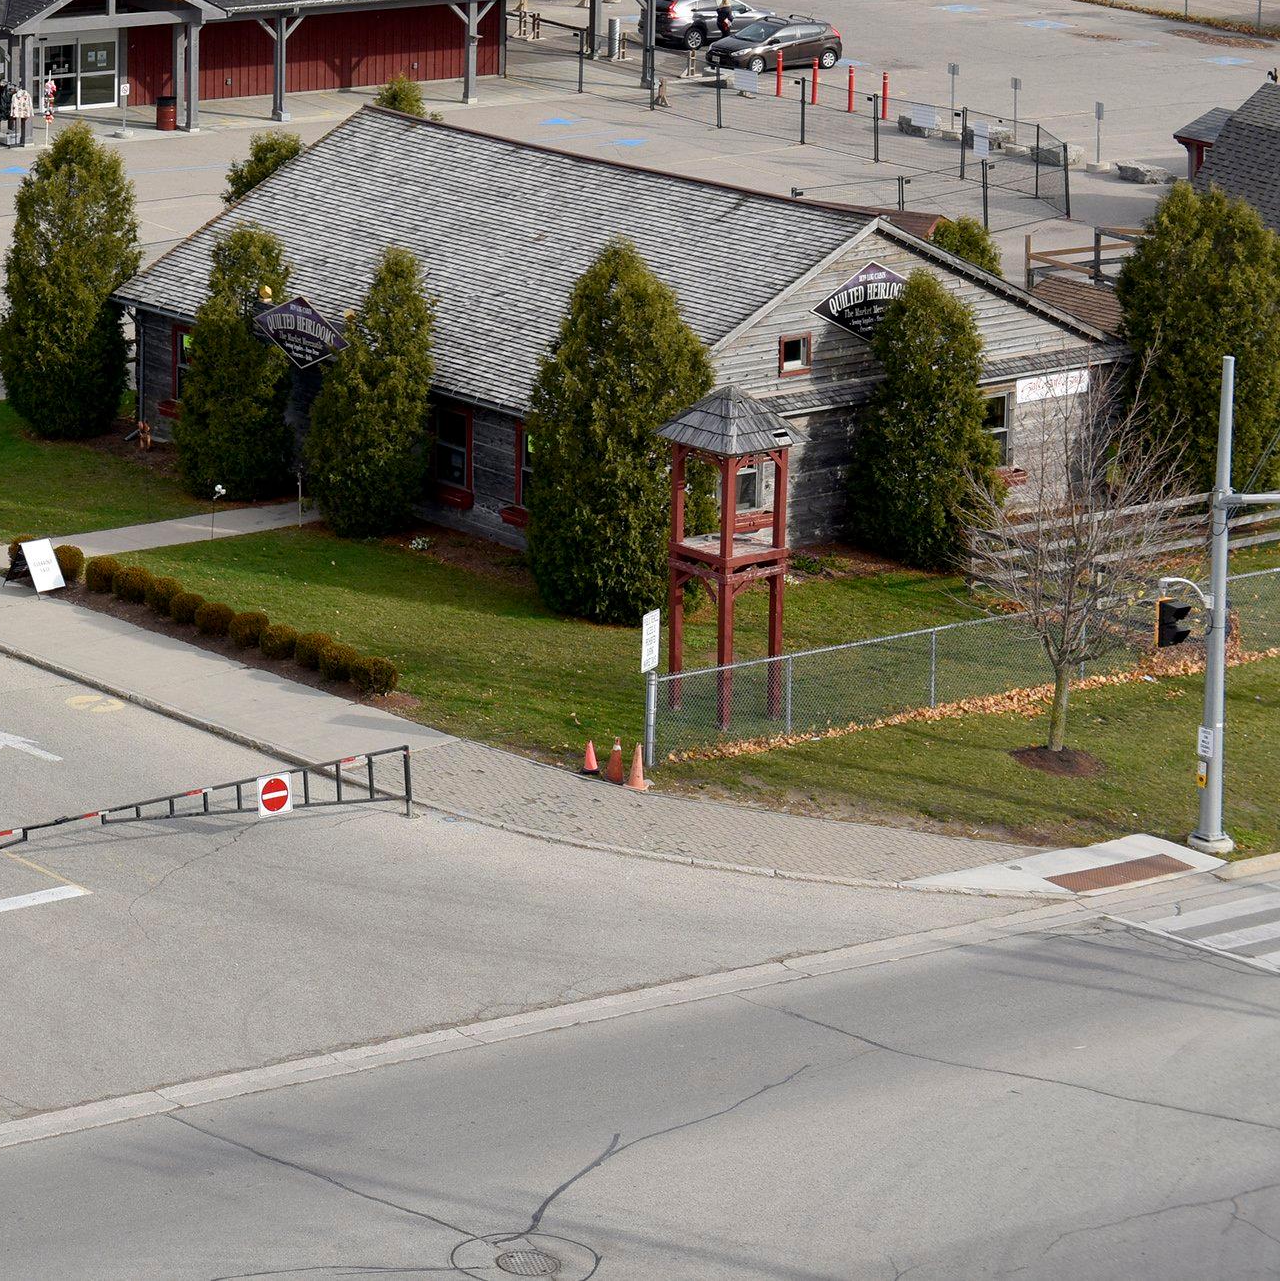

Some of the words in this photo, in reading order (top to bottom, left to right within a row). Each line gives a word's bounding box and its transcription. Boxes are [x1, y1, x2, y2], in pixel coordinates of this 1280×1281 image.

[828, 285, 864, 316] QUILTED
[866, 282, 905, 301] HEIRLOO
[855, 307, 873, 316] Market
[266, 313, 295, 334] QUILTED
[296, 316, 336, 345] HEIRLOOMS
